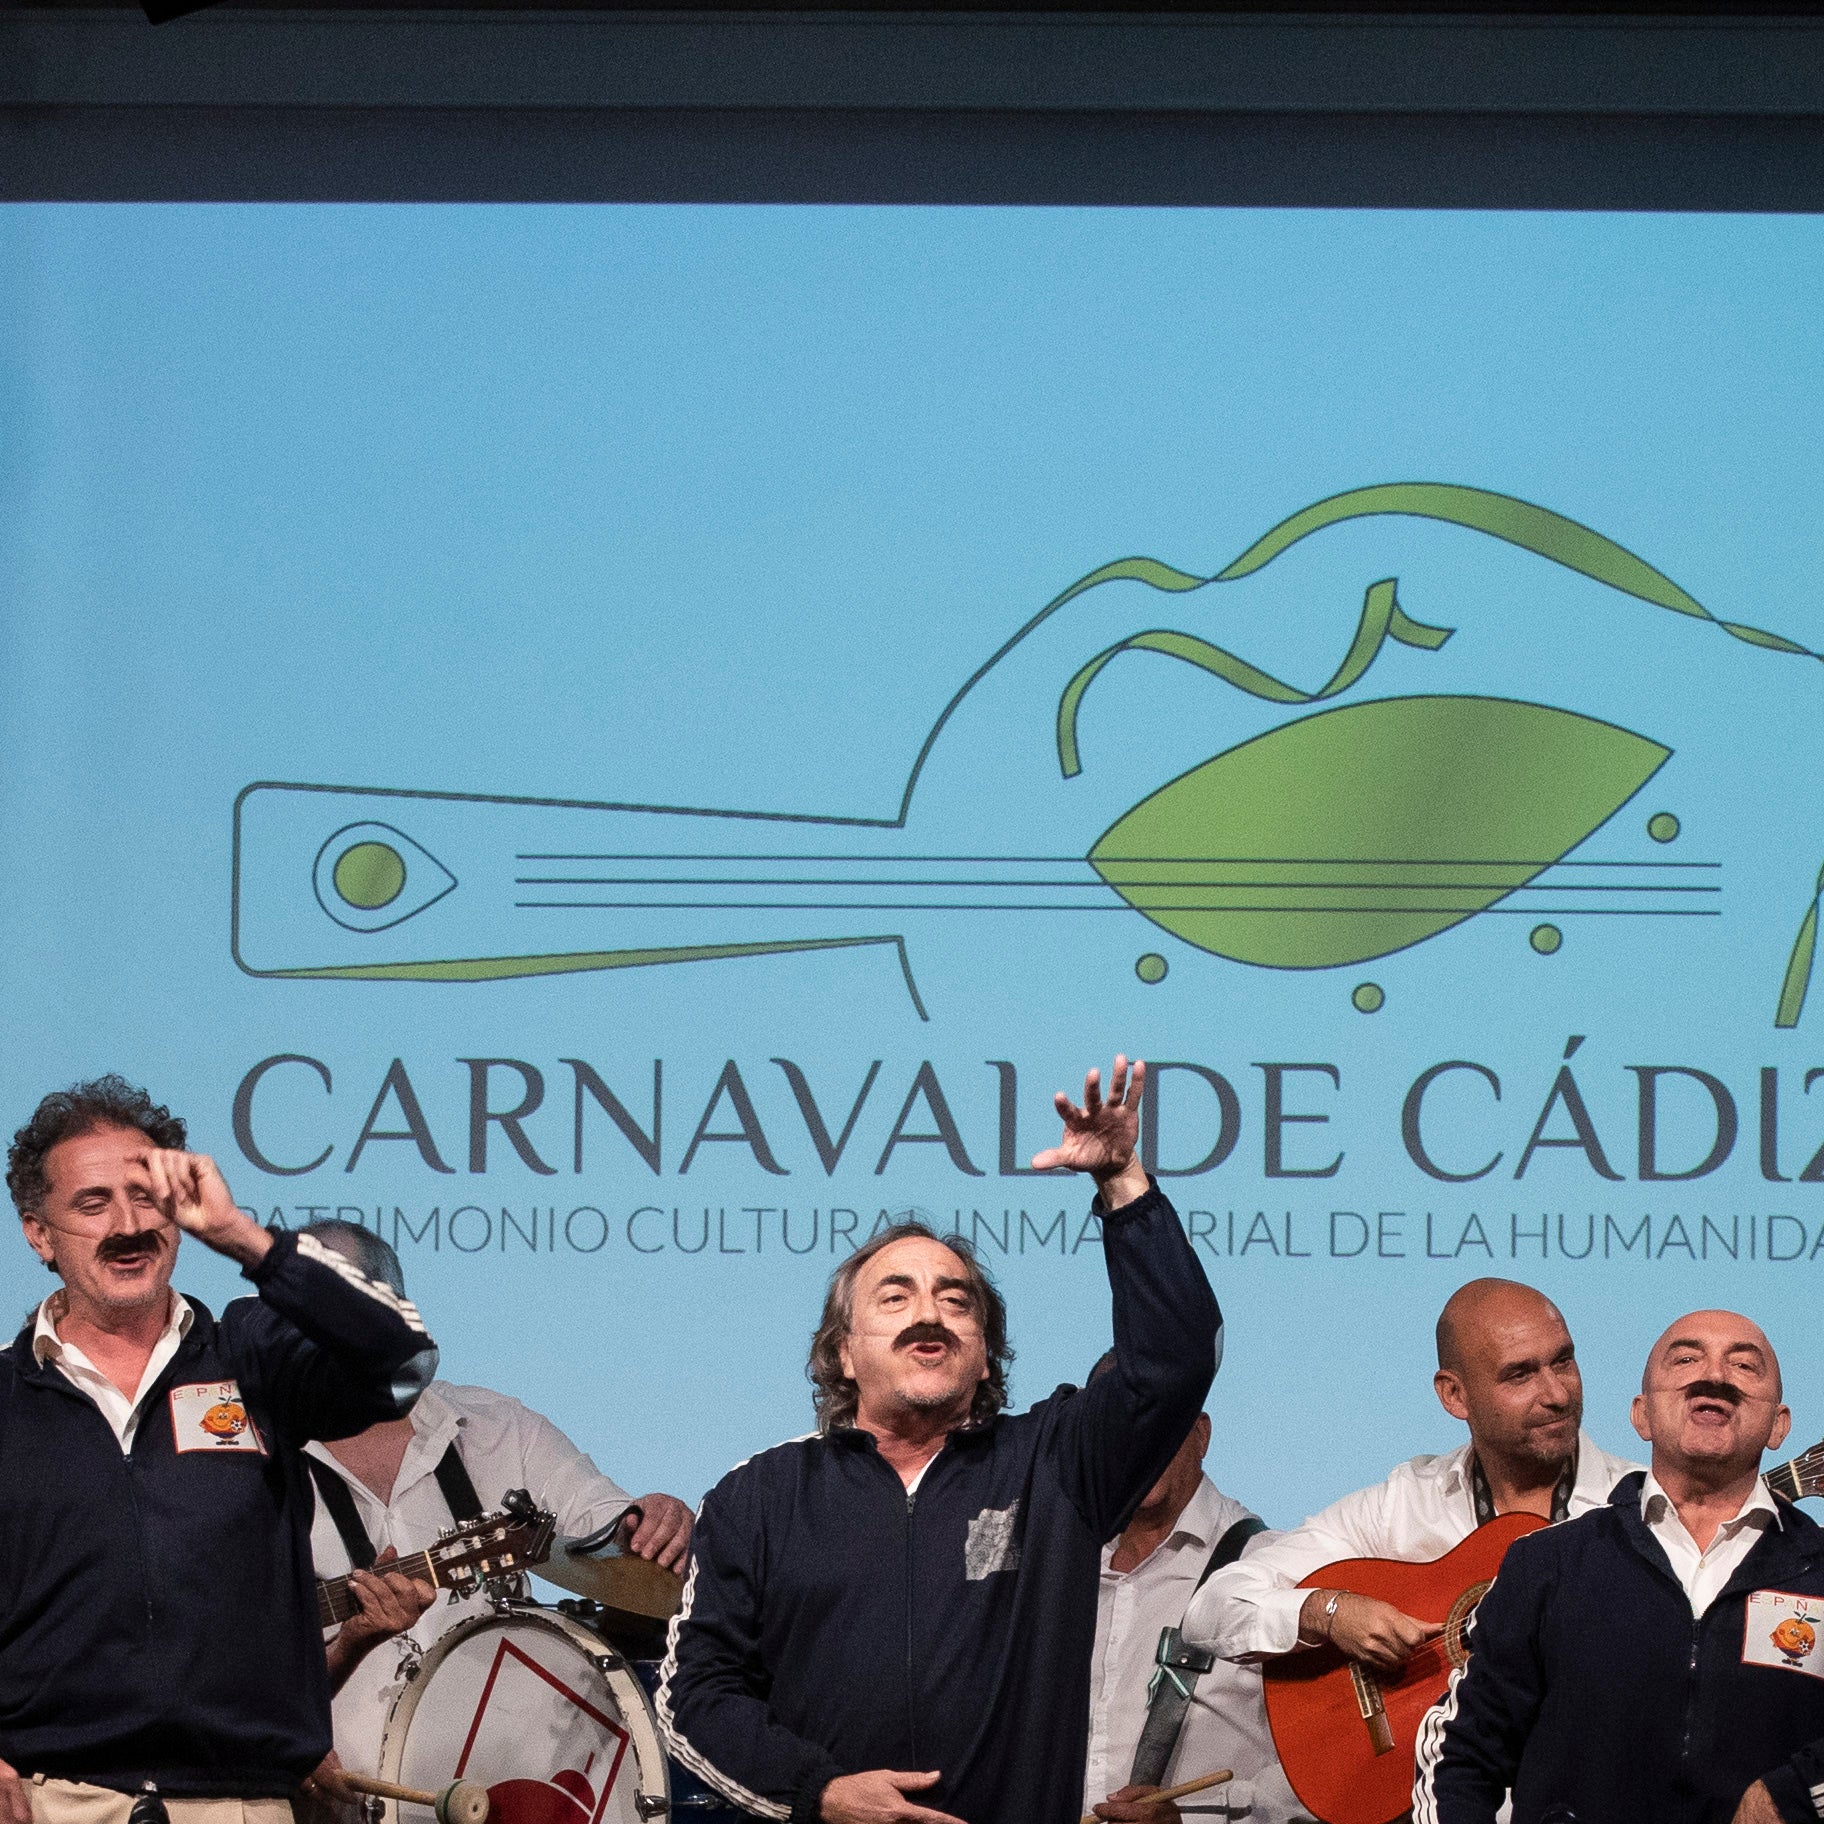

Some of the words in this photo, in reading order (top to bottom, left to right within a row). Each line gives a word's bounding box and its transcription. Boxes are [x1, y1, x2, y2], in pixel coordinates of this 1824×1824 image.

[231, 1053, 1090, 1177] CARNAVAL
[1128, 1060, 1345, 1178] DE
[627, 1206, 914, 1256] CULTURA
[954, 1209, 1312, 1257] INMARIAL
[1329, 1211, 1406, 1258] DE
[1426, 1212, 1494, 1259] LA
